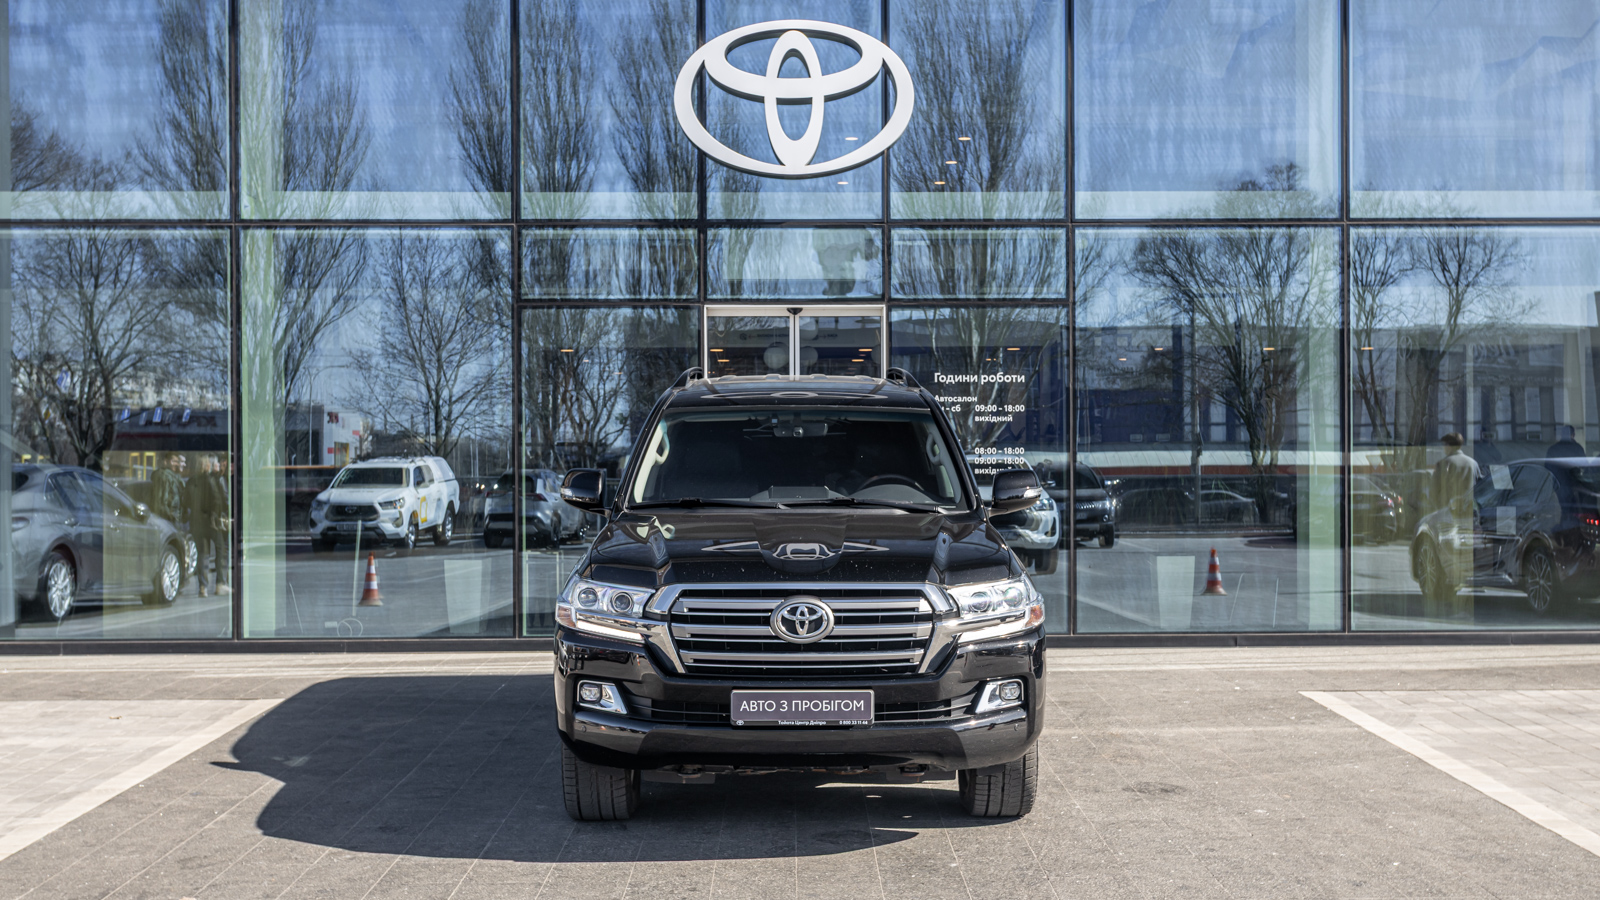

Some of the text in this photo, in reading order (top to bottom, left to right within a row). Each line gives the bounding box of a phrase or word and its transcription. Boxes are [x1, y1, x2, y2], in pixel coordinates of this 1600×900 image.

[934, 372, 1025, 385] Години роботи
[934, 395, 978, 403] Автосалон
[951, 404, 961, 413] сб
[975, 414, 1013, 423] вихідний
[975, 466, 1013, 475] вихід
[740, 700, 864, 712] АВТО З ПРОБІГОМ
